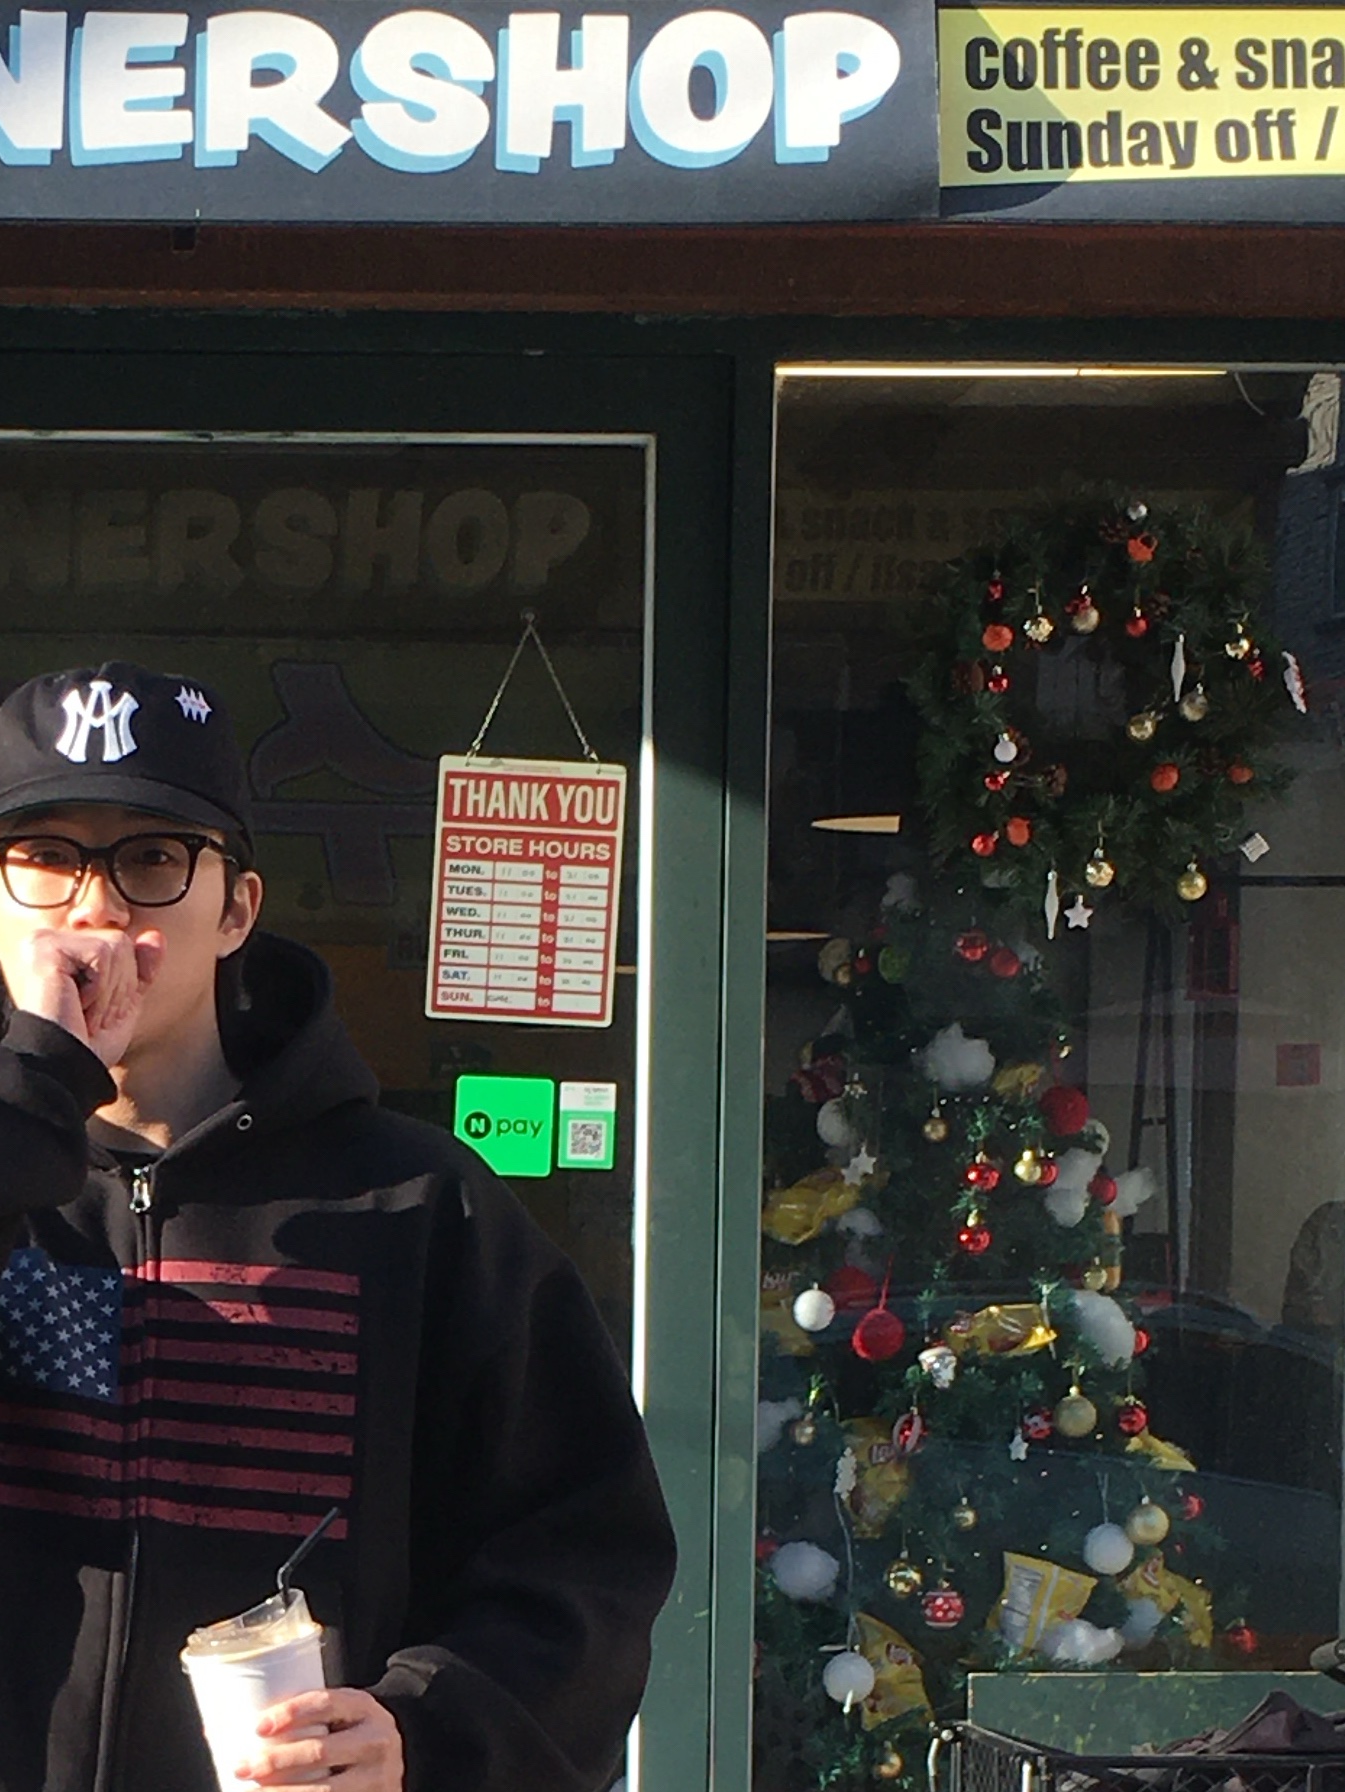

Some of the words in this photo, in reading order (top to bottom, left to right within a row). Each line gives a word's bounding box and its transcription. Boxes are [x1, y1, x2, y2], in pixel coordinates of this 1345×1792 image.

[964, 27, 1161, 92] coffee
[1176, 37, 1220, 92] &
[1234, 37, 1345, 91] sna
[965, 107, 1199, 173] Sunday
[1213, 108, 1297, 164] off
[1314, 105, 1340, 162] /
[449, 778, 550, 822] THANK
[555, 783, 616, 825] YOU
[446, 836, 524, 856] STORE
[528, 840, 611, 861] HOURS
[449, 864, 485, 876] MON.
[545, 869, 558, 880] to
[447, 885, 487, 897] TUES.
[544, 889, 556, 902] to
[446, 906, 481, 918] WED.
[543, 911, 556, 923] to
[445, 928, 486, 940] THUR.
[541, 933, 554, 944] to
[540, 954, 553, 965] to
[442, 970, 471, 981] SAT.
[539, 975, 552, 986] to
[440, 991, 473, 1002] SUN.
[537, 996, 550, 1007] to
[469, 1118, 486, 1133] N
[495, 1118, 545, 1138] pay
